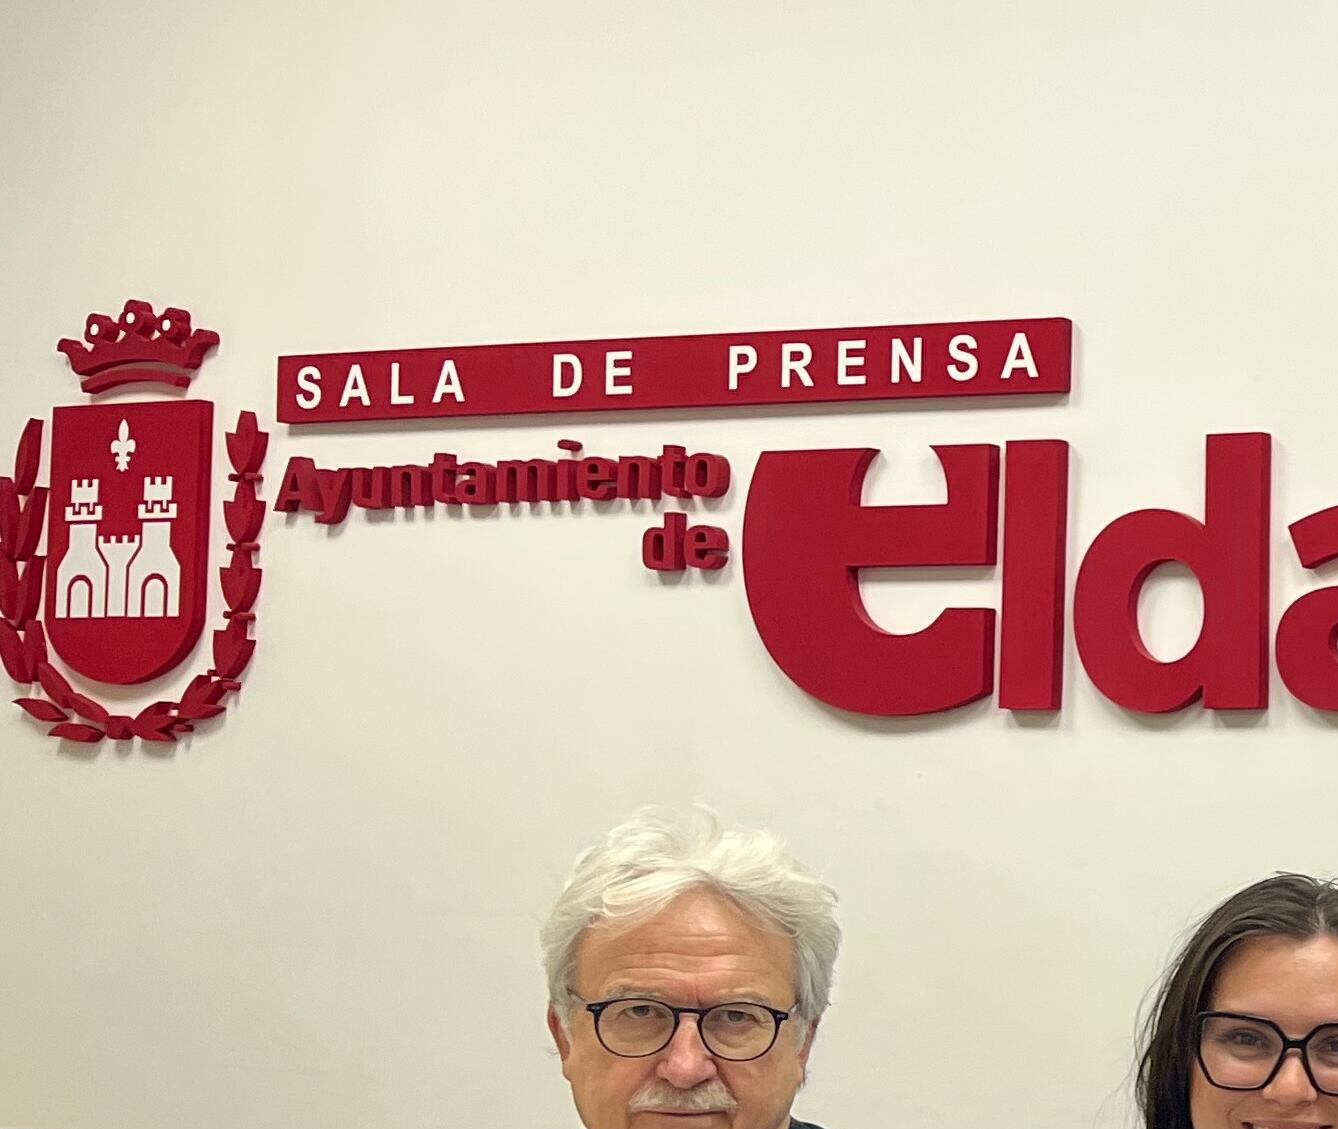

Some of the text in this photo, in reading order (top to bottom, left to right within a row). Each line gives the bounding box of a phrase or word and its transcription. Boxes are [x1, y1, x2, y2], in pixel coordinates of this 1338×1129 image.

[295, 331, 1042, 411] SALA DE PRENSA
[273, 437, 731, 530] Ayuntamiento
[641, 512, 731, 575] de
